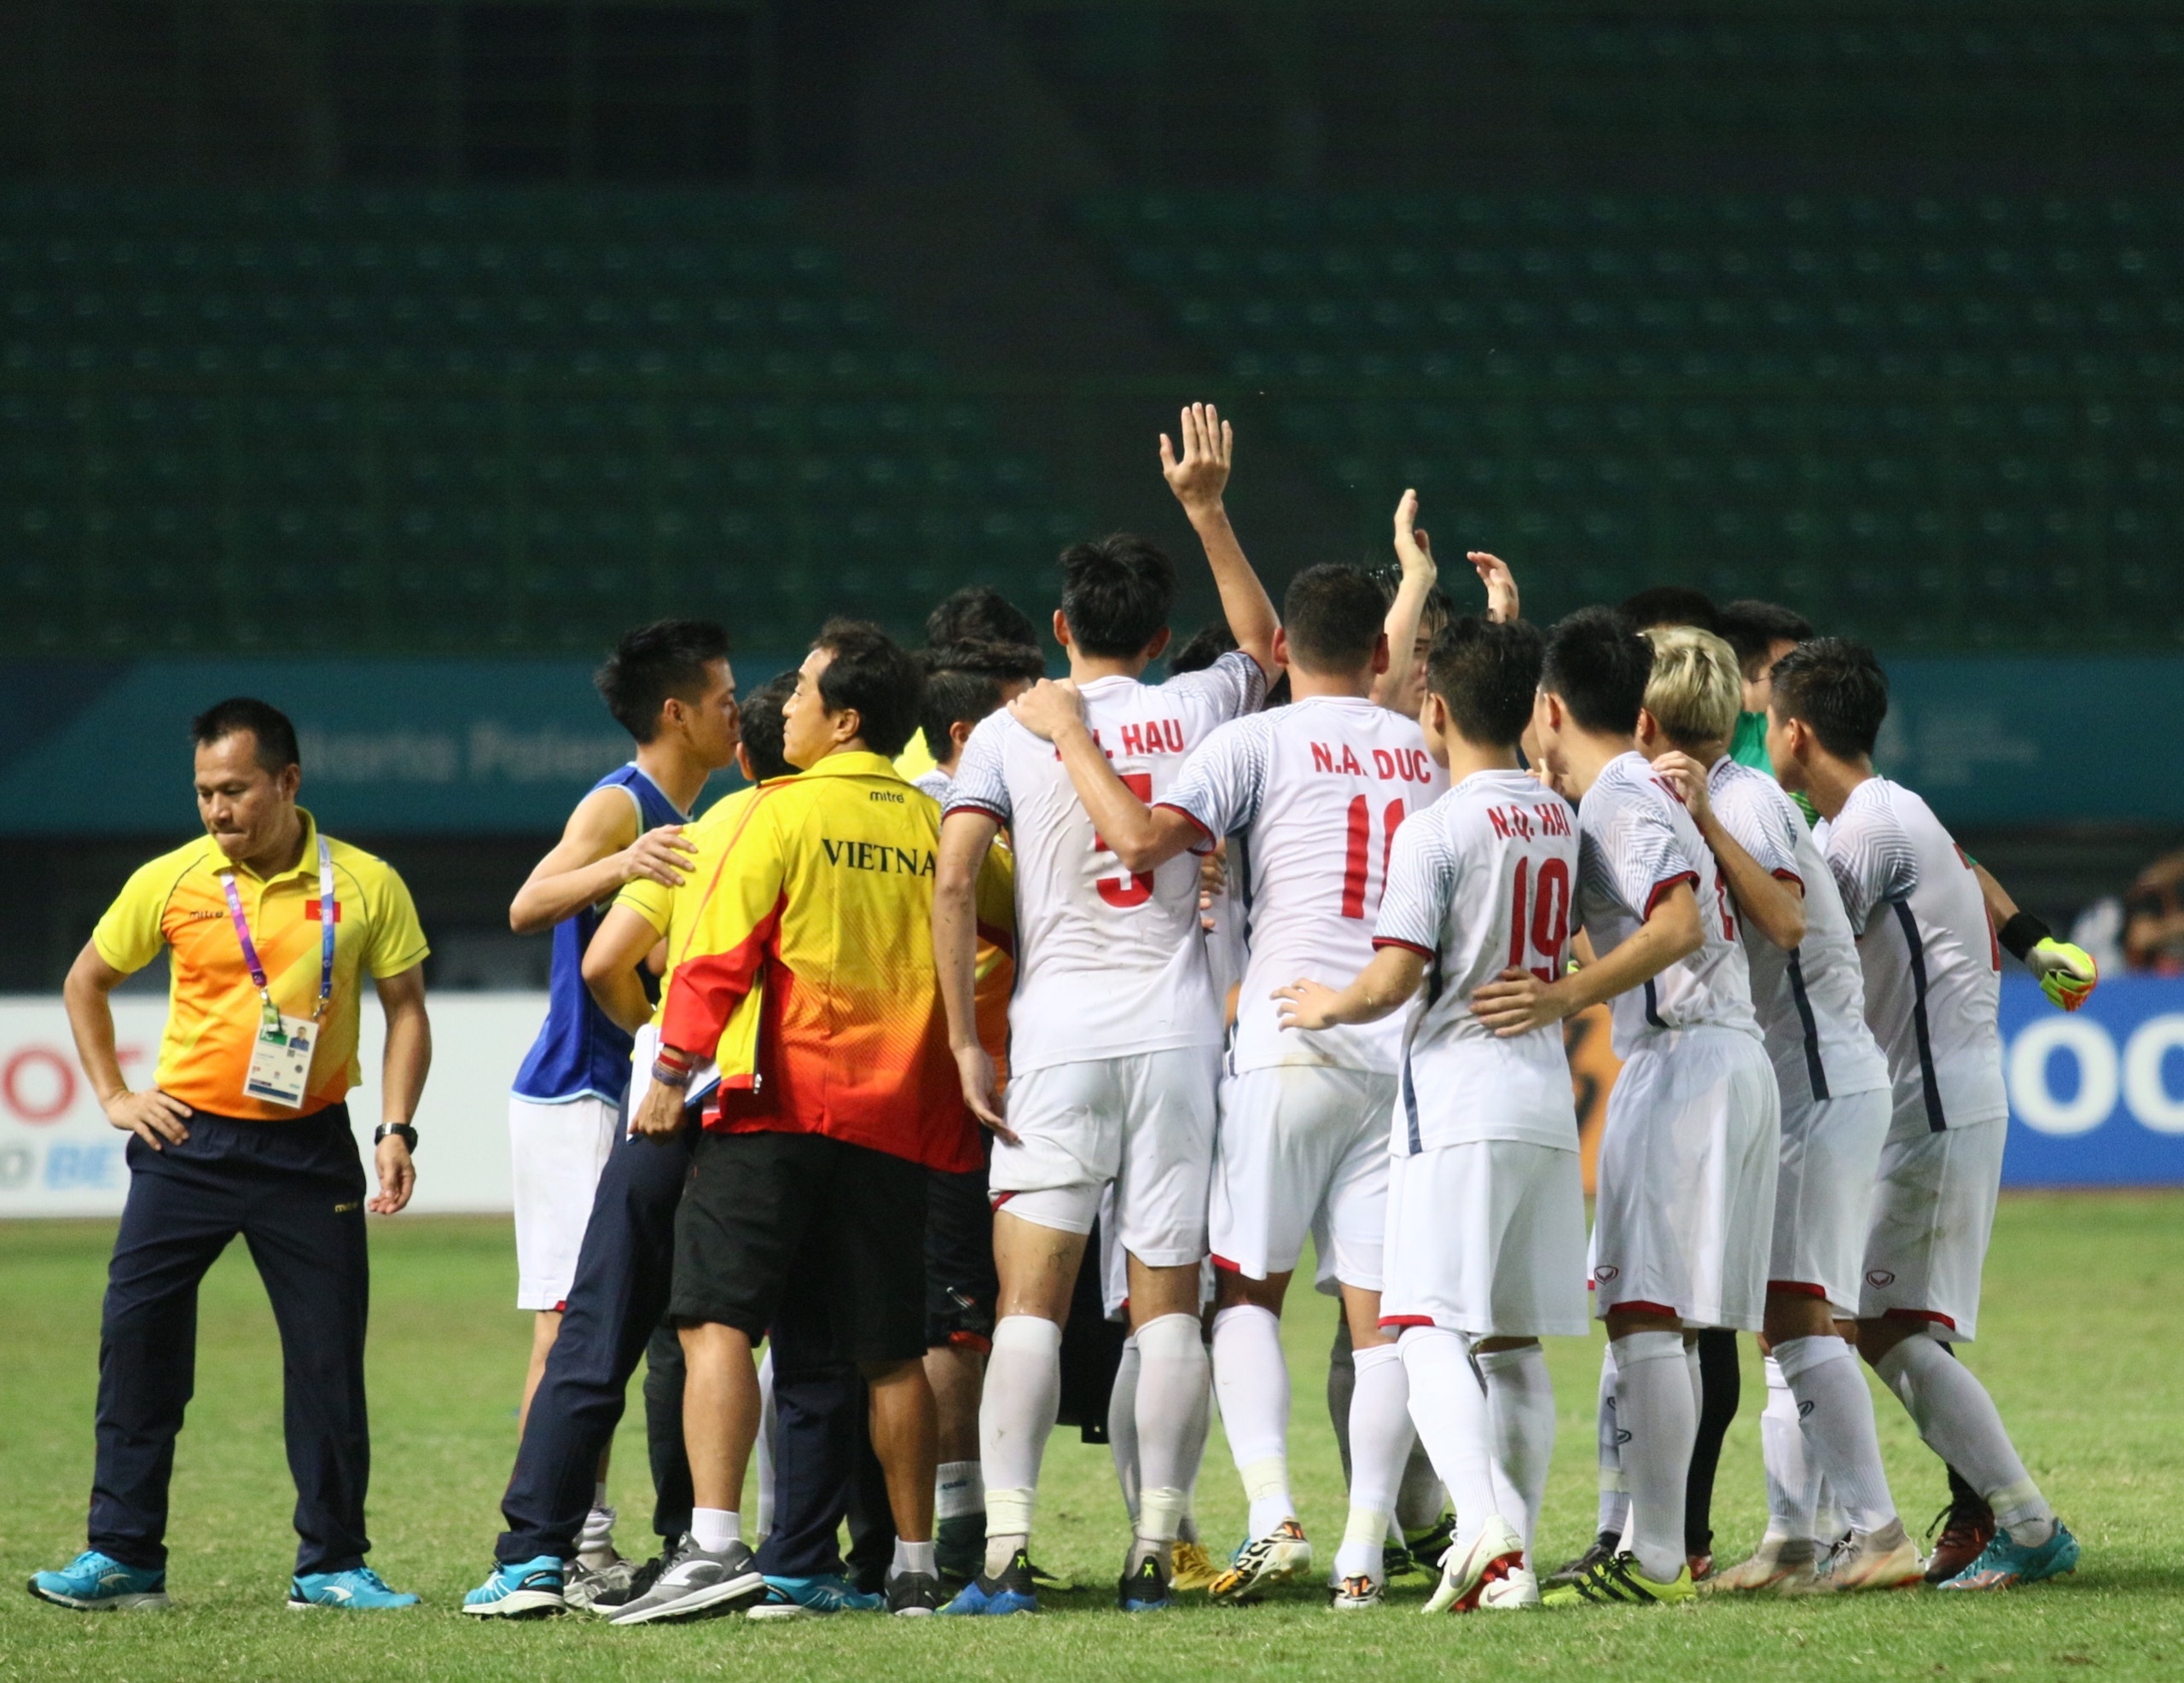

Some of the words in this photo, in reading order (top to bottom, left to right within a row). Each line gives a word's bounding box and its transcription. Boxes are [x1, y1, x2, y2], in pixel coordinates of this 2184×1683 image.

[1121, 719, 1184, 756] HAU
[1310, 741, 1368, 777] N.A.
[1372, 748, 1432, 784] DUC
[870, 791, 905, 804] mitre
[1487, 804, 1535, 843] N.Q.
[1534, 803, 1571, 837] HAI
[822, 839, 936, 878] VIETNA
[1508, 856, 1570, 984] 19
